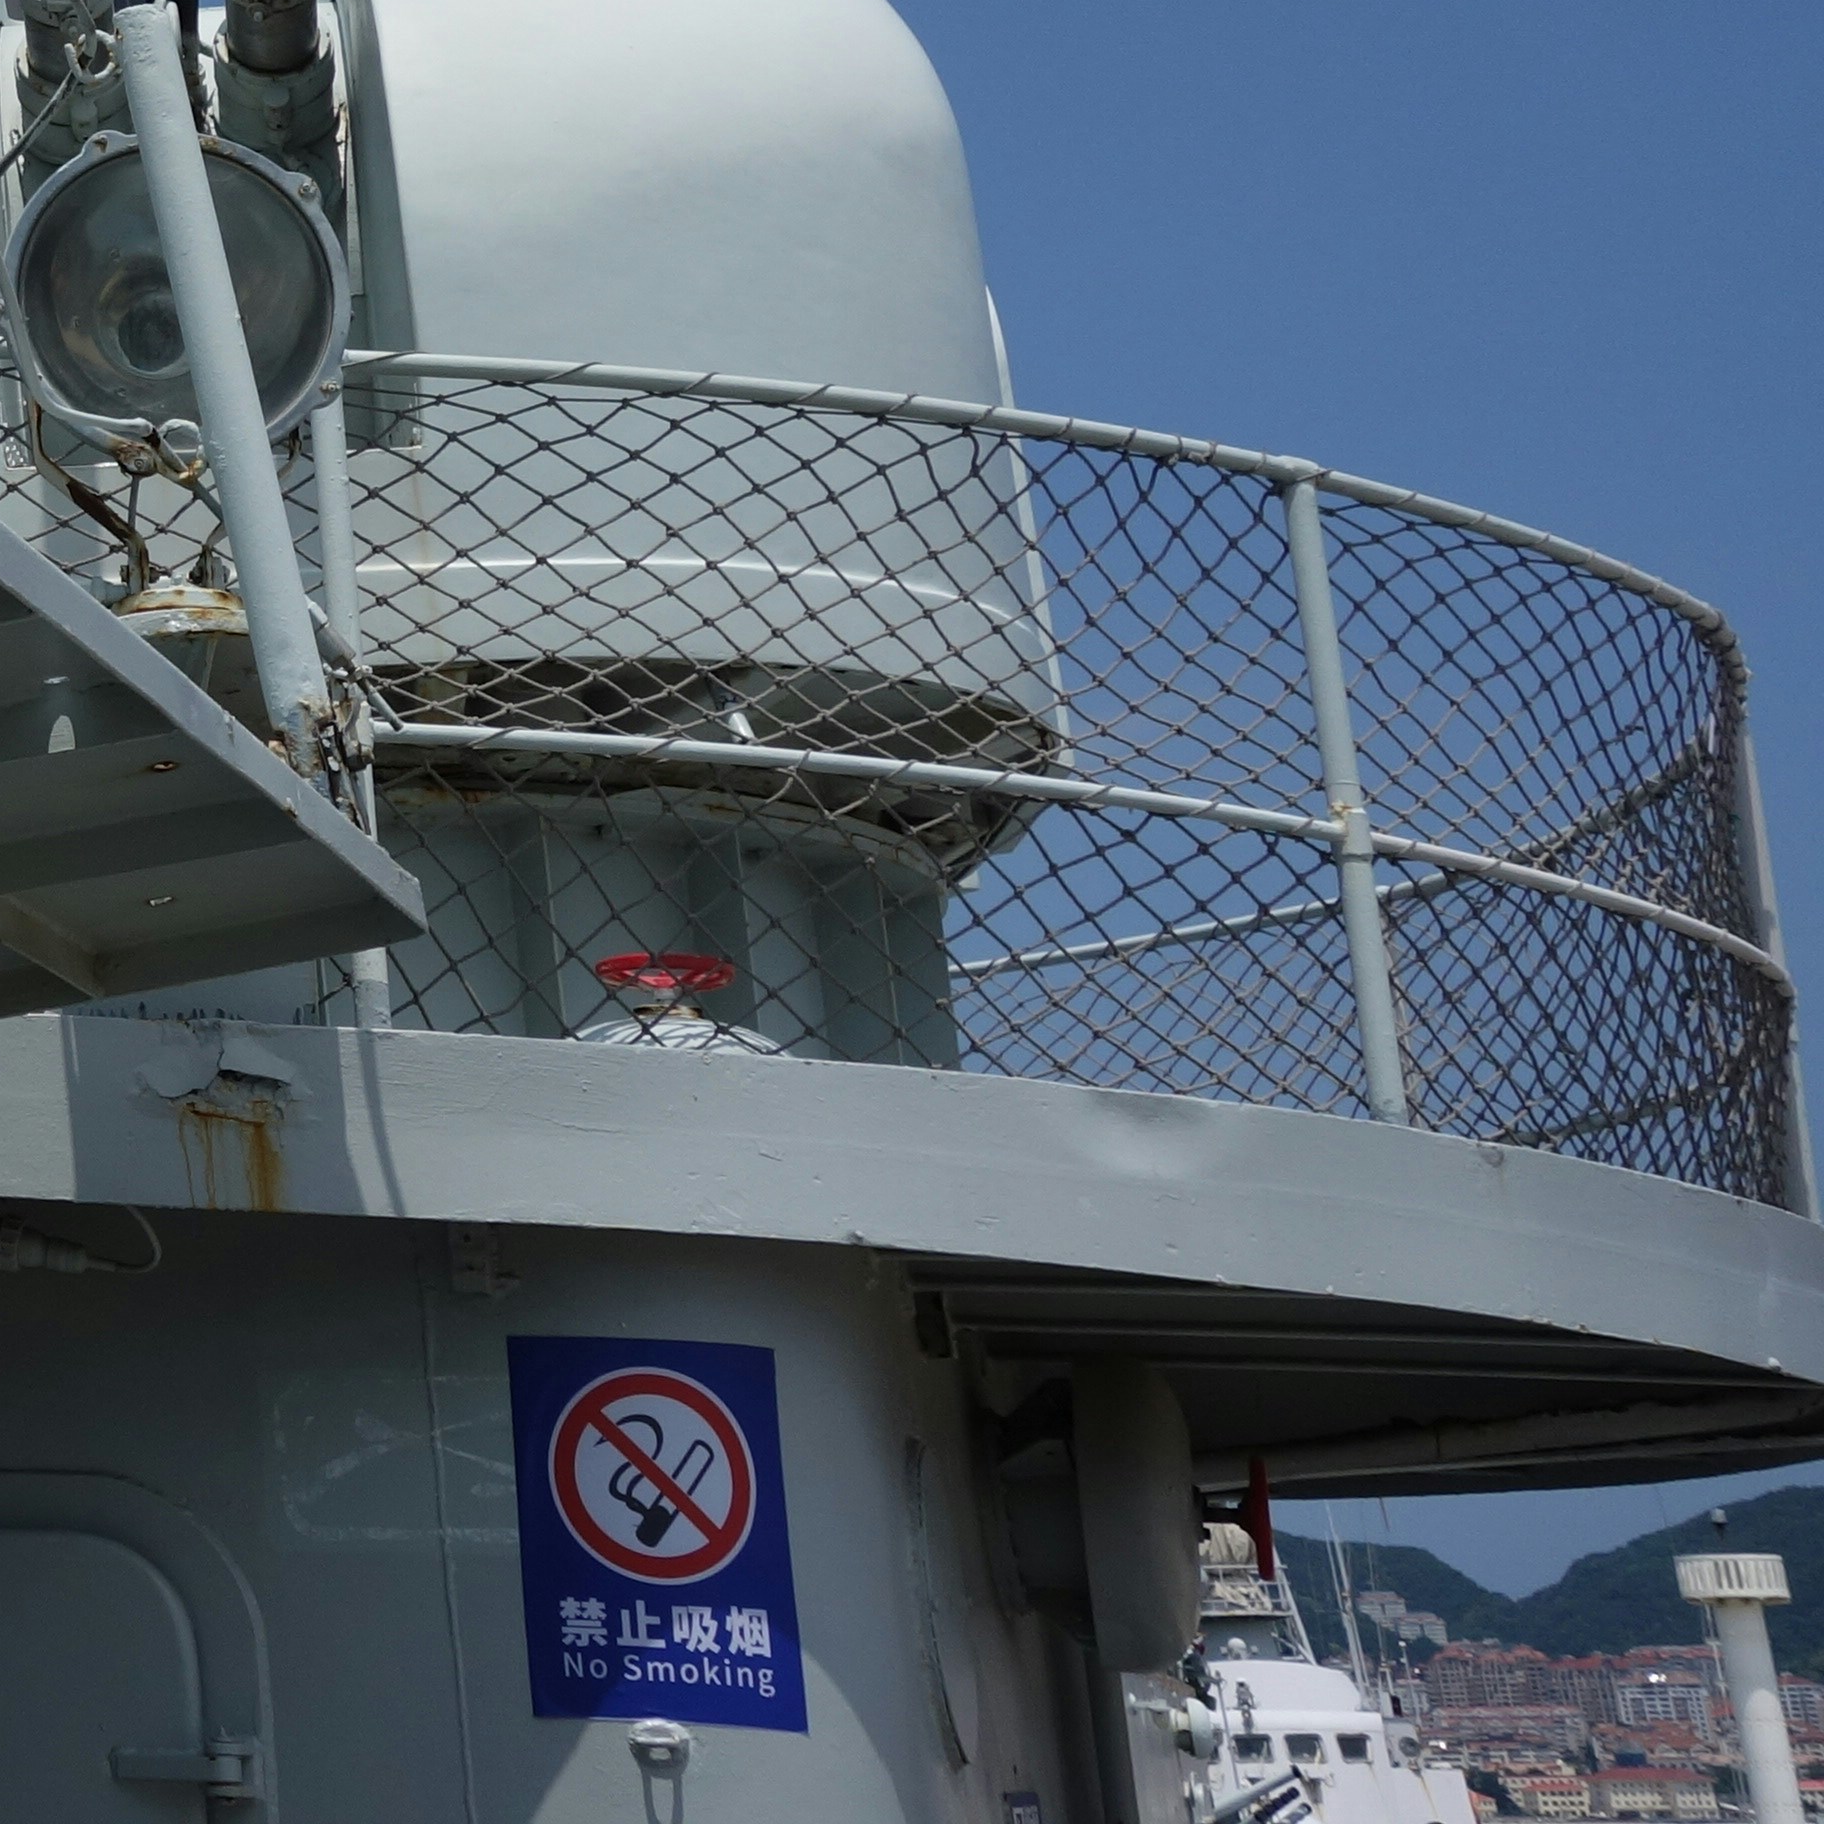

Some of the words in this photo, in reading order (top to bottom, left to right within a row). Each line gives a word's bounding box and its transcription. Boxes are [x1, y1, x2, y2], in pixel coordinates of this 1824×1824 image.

[560, 1598, 772, 1657] 禁止吸烟
[564, 1653, 608, 1678] No
[624, 1655, 776, 1697] Smoking
